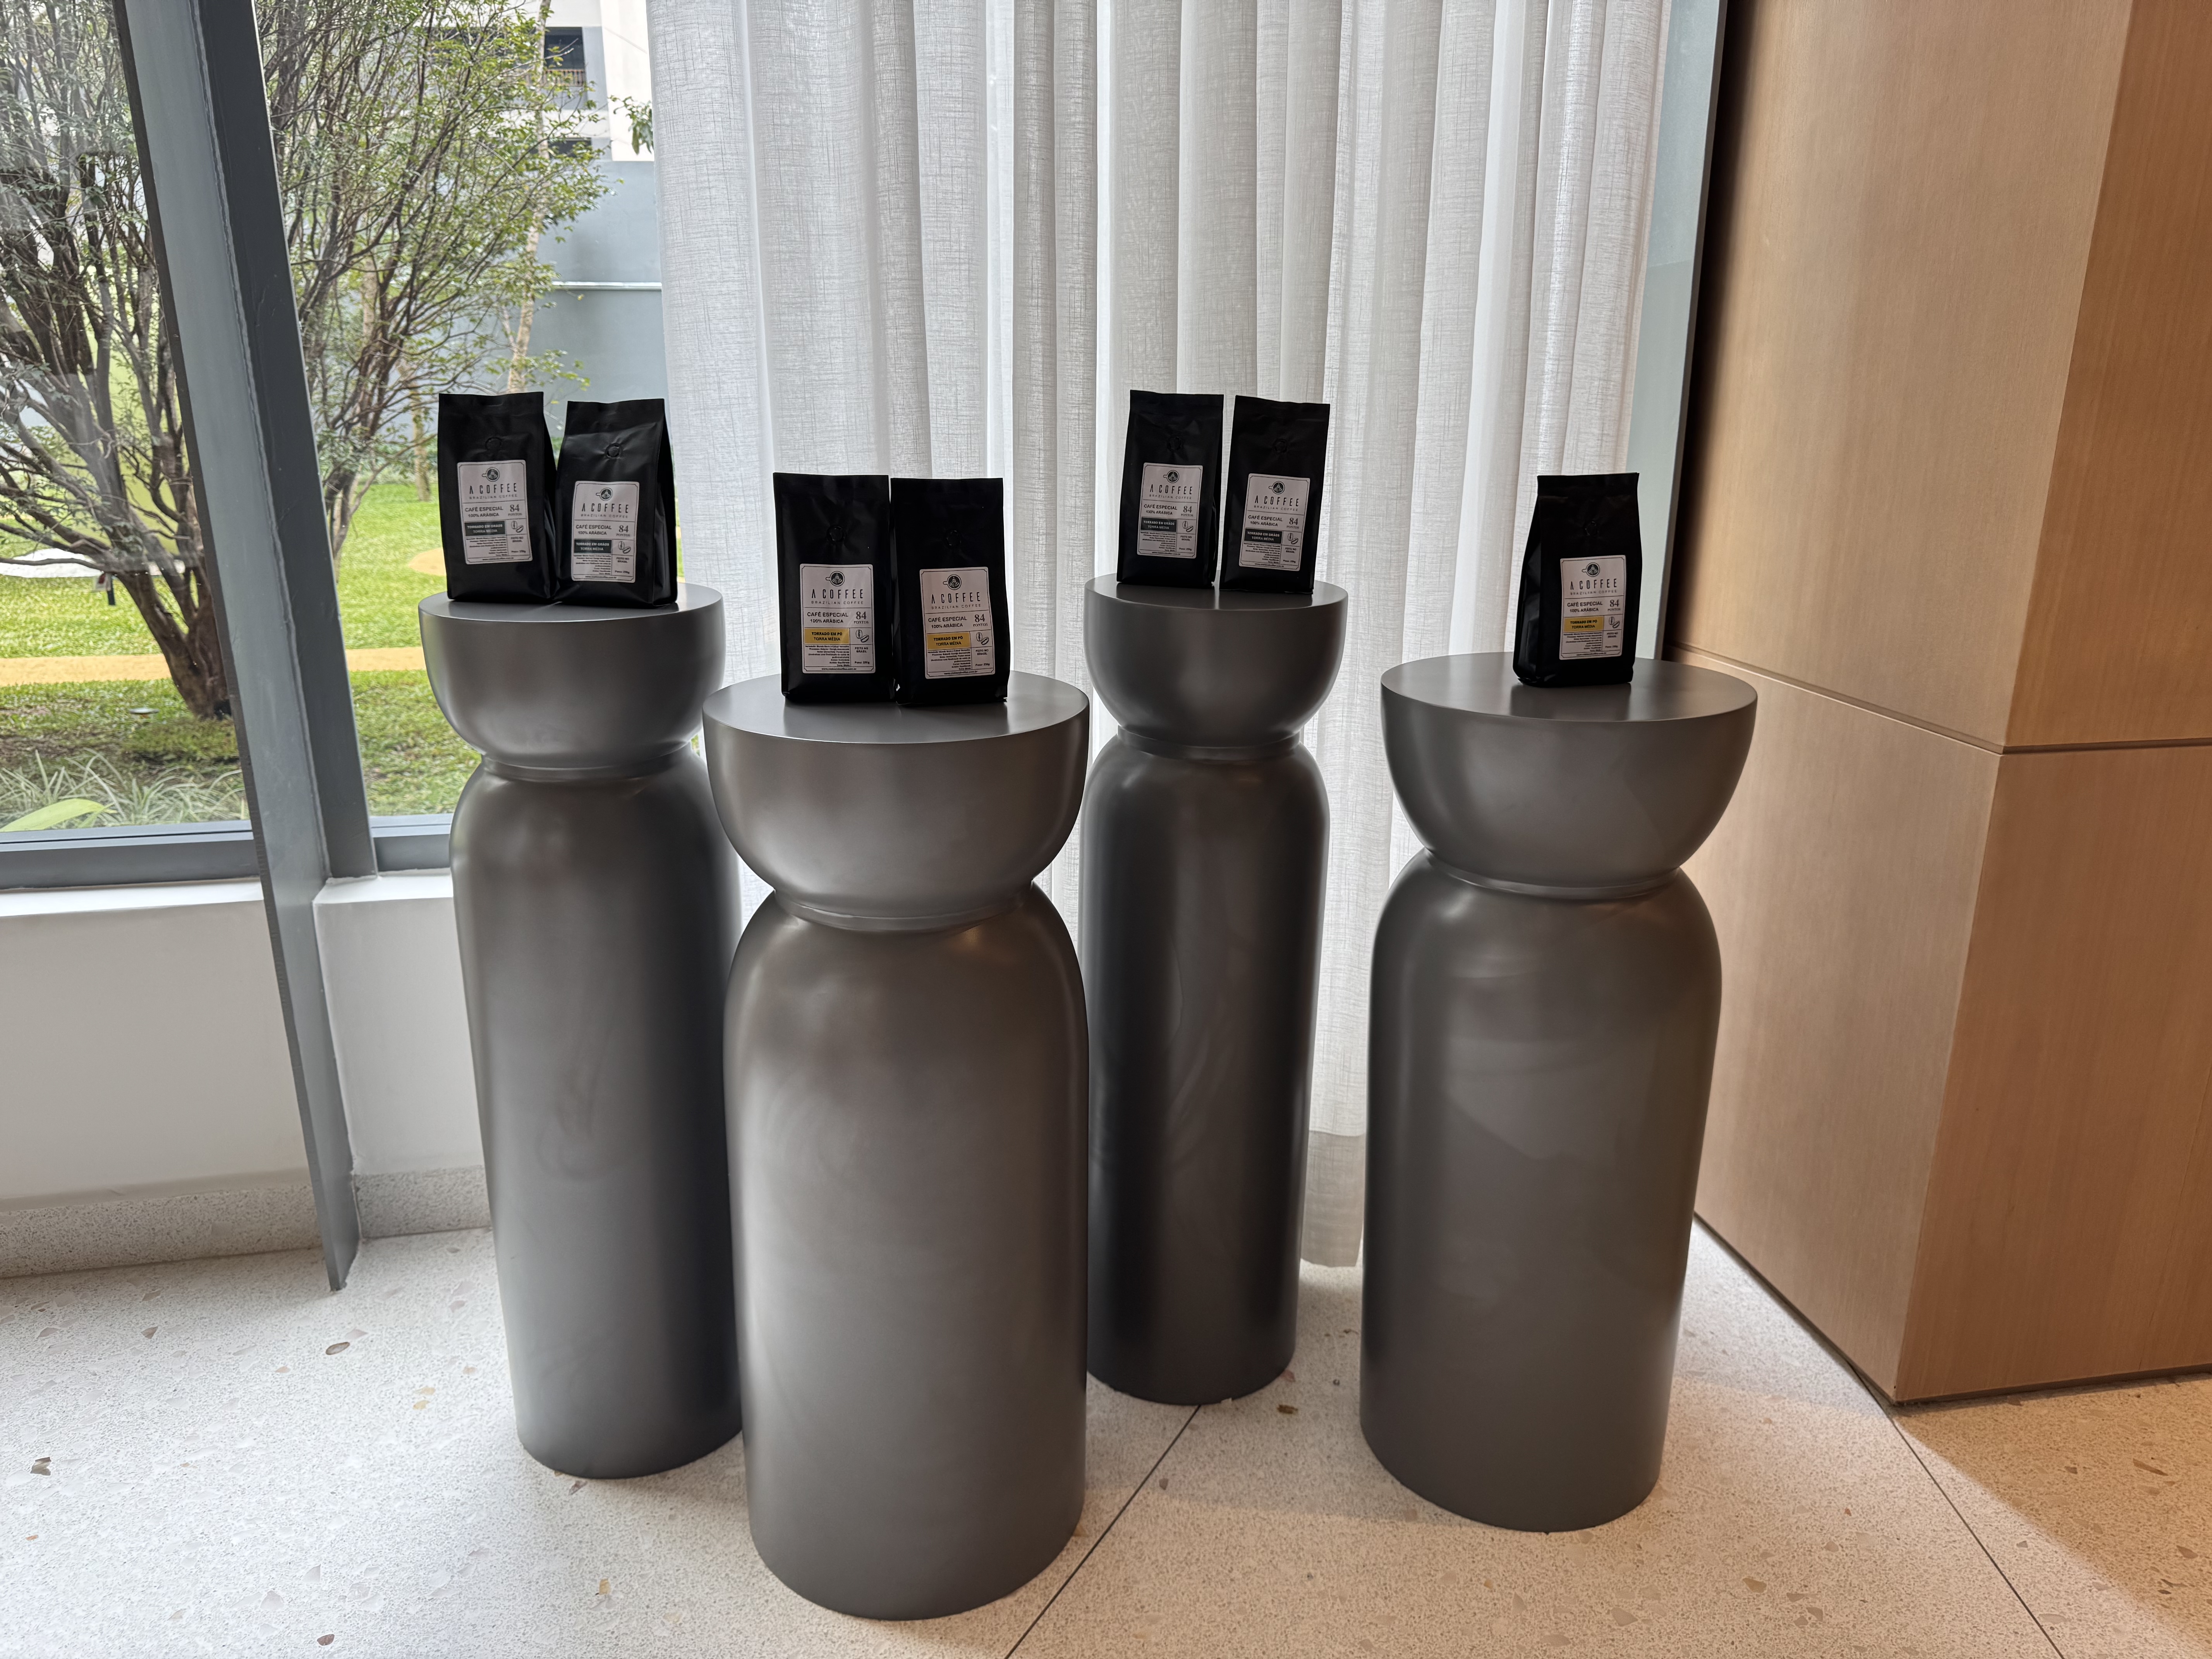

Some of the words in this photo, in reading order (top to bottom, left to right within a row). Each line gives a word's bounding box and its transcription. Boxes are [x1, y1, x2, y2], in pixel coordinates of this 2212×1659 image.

[470, 486, 473, 494] A
[480, 483, 517, 494] COFFEE
[1150, 484, 1153, 492] A
[1159, 485, 1192, 495] COFFEE
[1255, 495, 1258, 503] A
[1264, 496, 1299, 506] COFFEE
[582, 503, 585, 512] A
[591, 503, 629, 513] COFFEE
[1570, 581, 1573, 590] A
[1580, 579, 1617, 589] COFFEE
[812, 589, 816, 598] A
[823, 589, 863, 599] COFFEE
[932, 594, 935, 604] A
[941, 592, 981, 603] COFFEE
[856, 611, 866, 620] 84
[974, 614, 985, 622] 84
